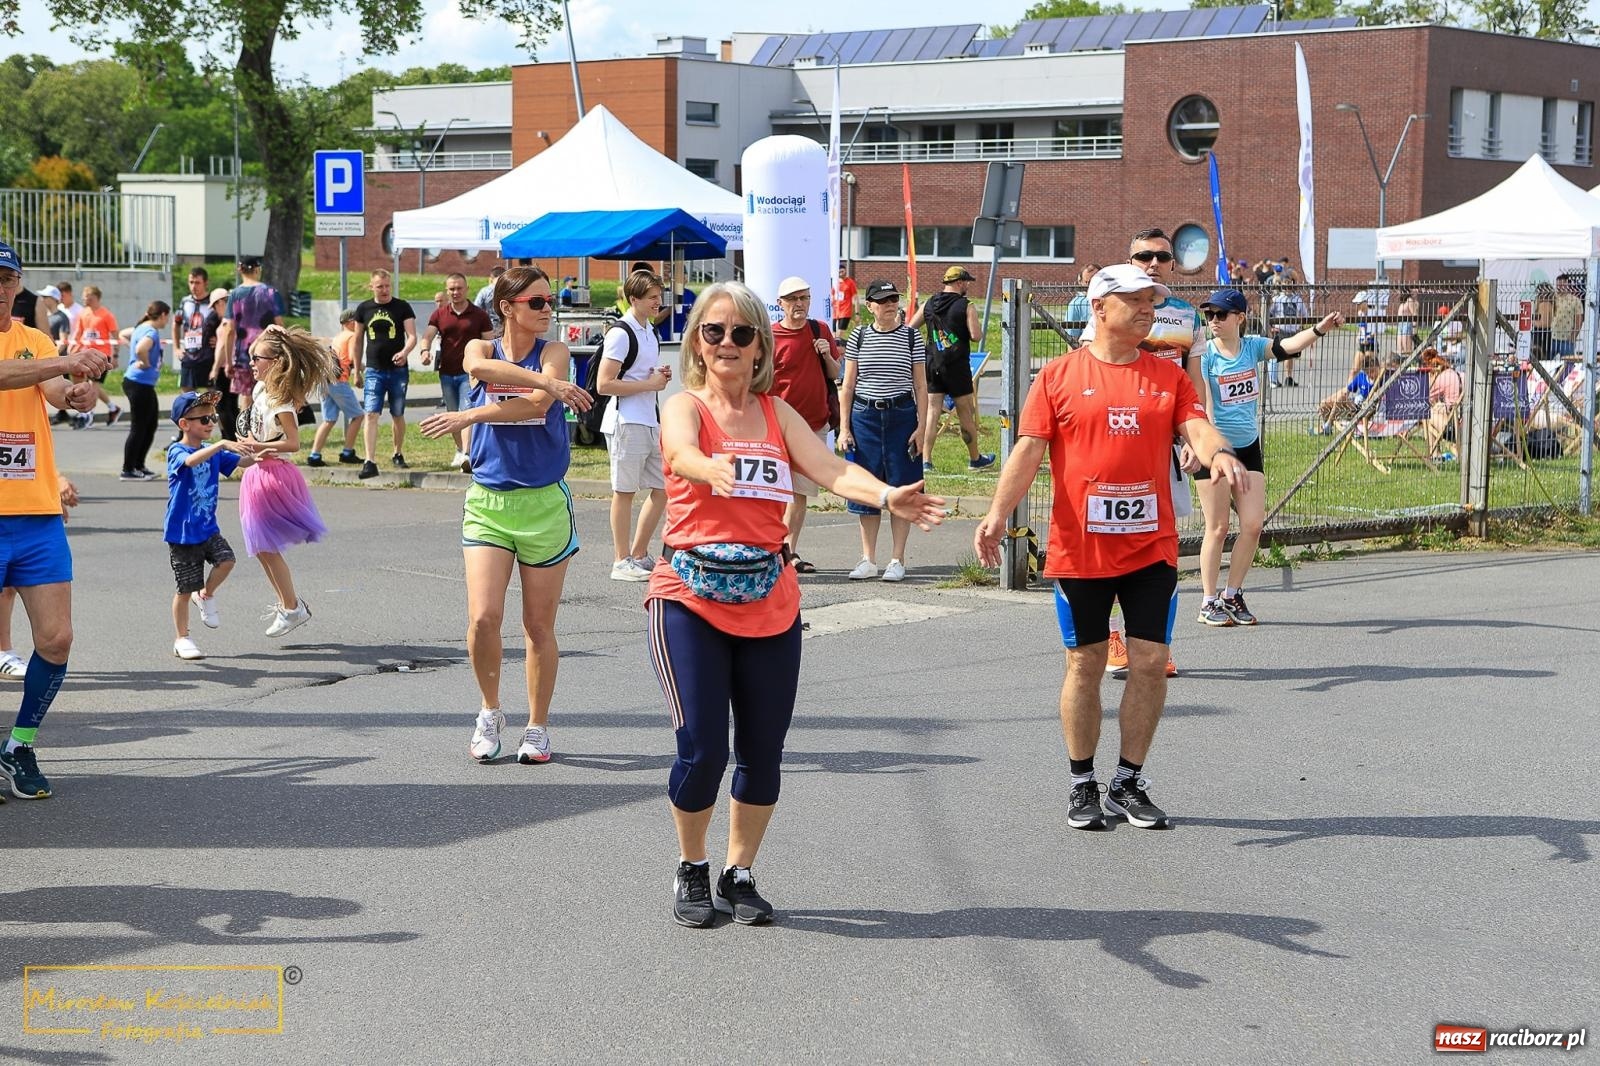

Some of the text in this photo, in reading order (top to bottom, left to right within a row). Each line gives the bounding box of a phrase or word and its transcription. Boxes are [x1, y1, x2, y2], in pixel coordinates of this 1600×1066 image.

[325, 158, 353, 207] P
[757, 195, 806, 206] Wodociągi
[758, 206, 807, 214] Raciborskie
[1228, 380, 1254, 397] 228
[735, 458, 778, 484] 175
[1104, 499, 1145, 521] 162
